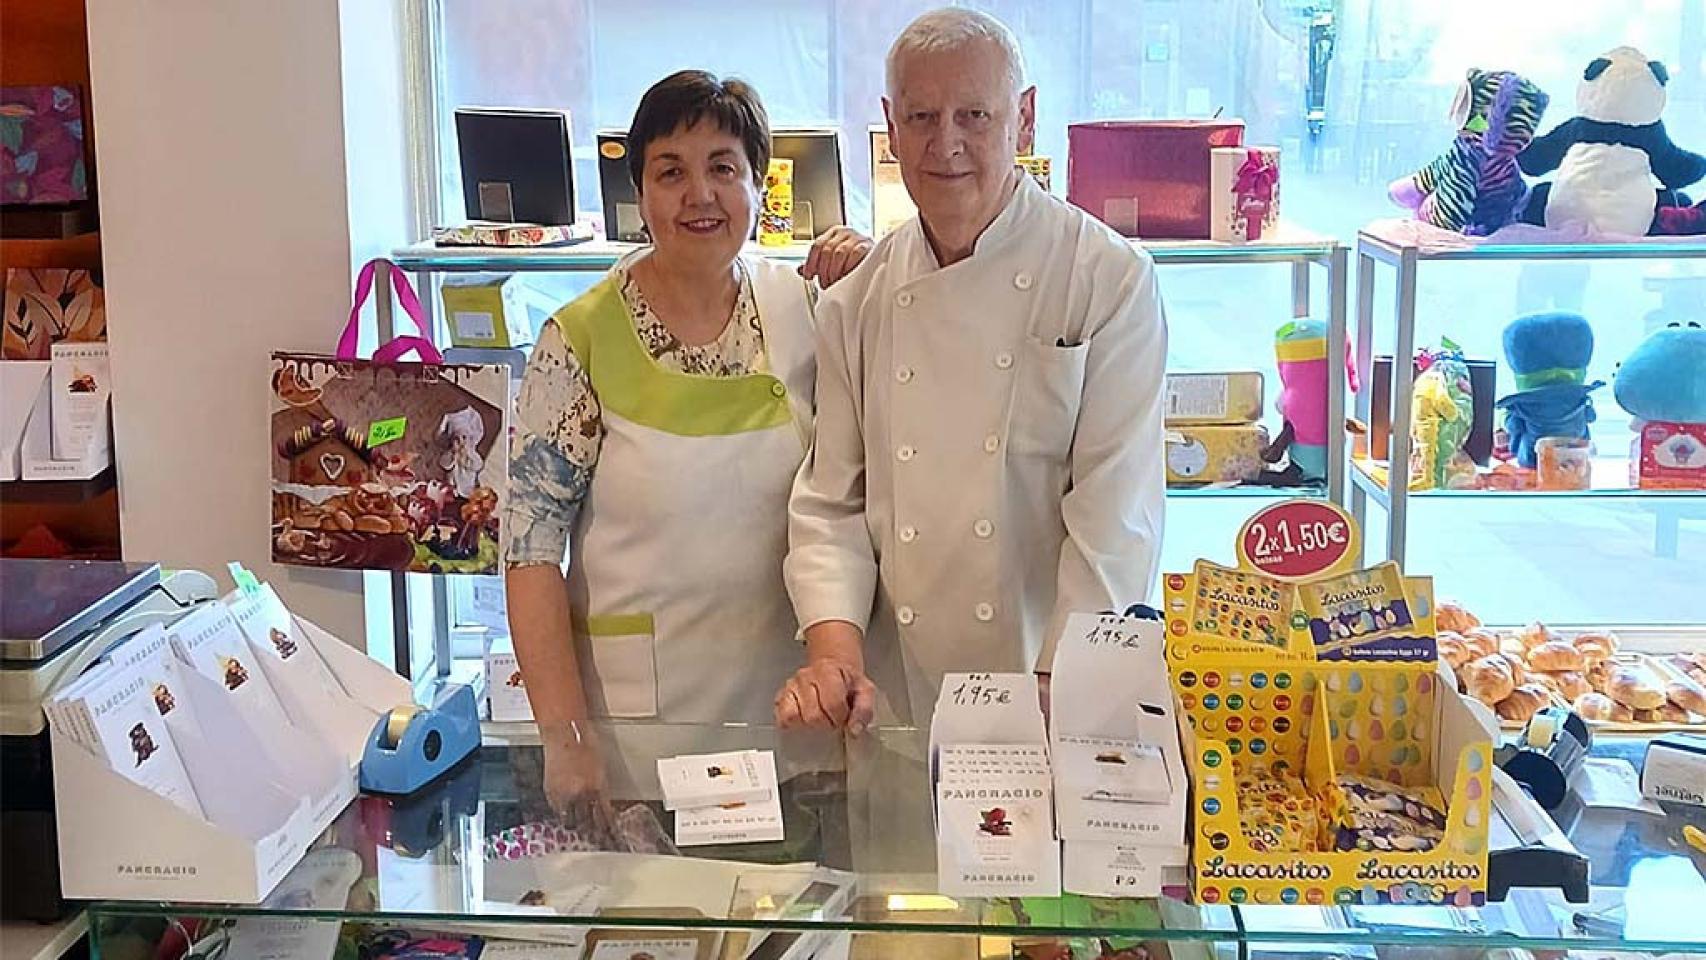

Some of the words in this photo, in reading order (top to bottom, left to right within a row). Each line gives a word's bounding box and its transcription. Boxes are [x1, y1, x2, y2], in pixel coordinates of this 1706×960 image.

[1209, 586, 1280, 611] Lacasitos
[1321, 583, 1386, 606] Lacasitos
[943, 788, 1044, 800] PANCRACIO
[1087, 819, 1161, 832] PANCRACIO
[117, 865, 197, 876] PANCRACIO
[1201, 855, 1332, 880] Lacasitos
[1356, 857, 1482, 881] Lacasitos
